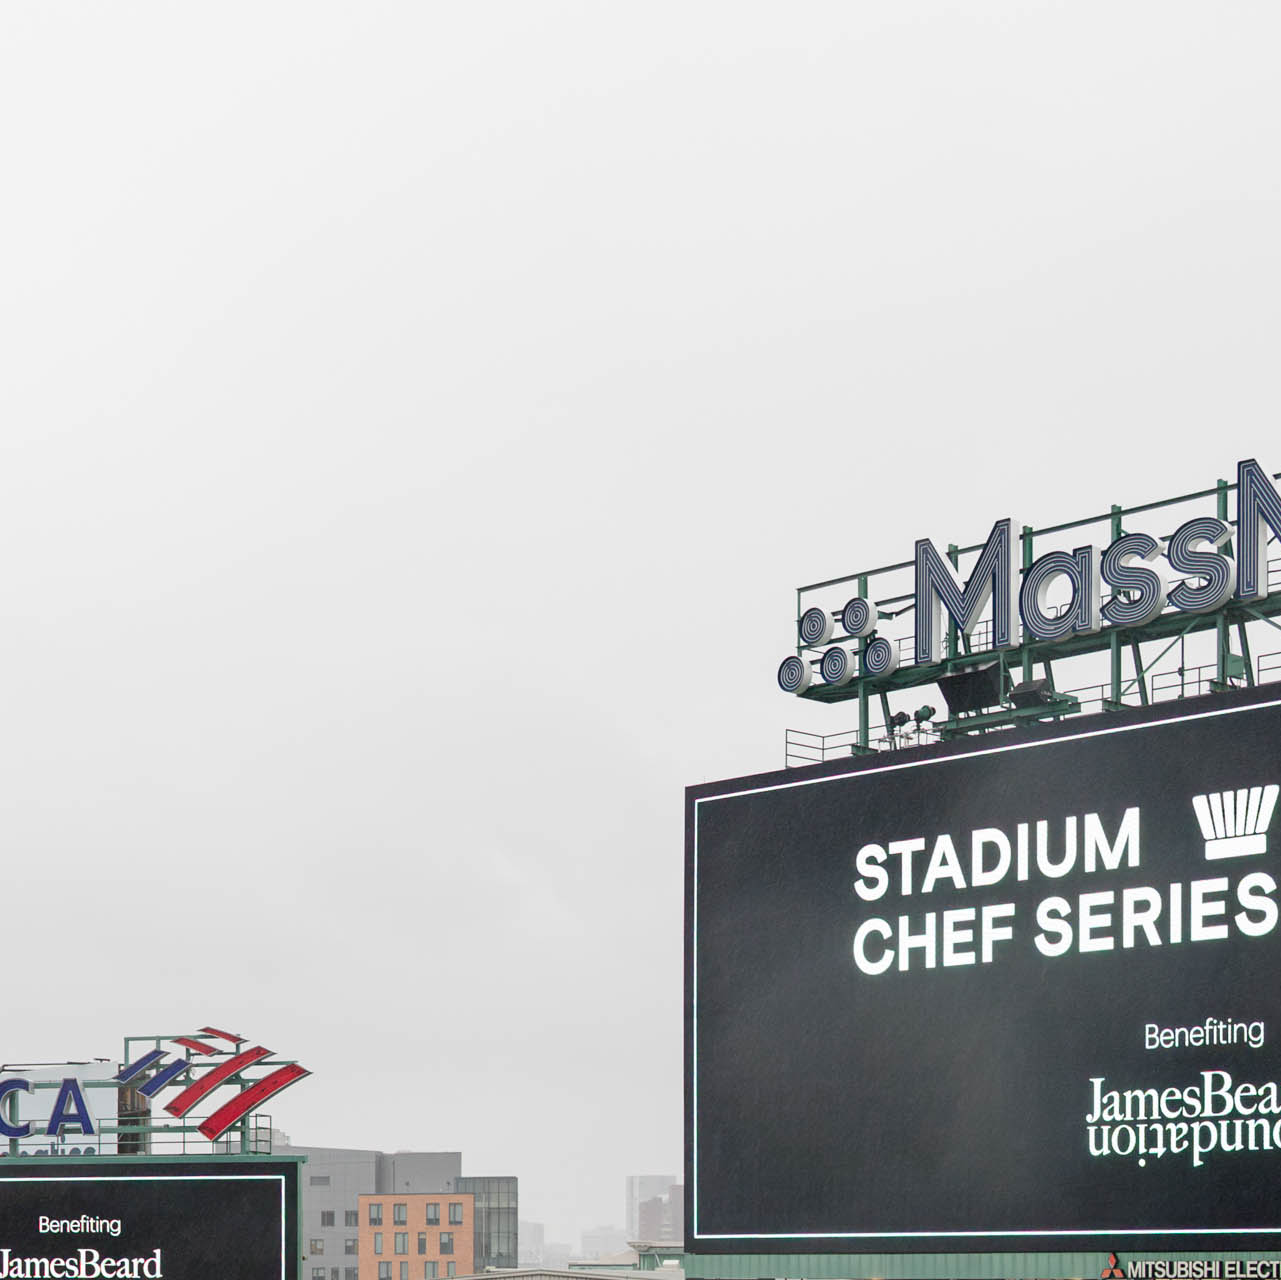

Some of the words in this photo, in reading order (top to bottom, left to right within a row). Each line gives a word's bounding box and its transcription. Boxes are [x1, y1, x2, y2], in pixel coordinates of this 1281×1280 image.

[853, 806, 1140, 901] STADIUM
[853, 902, 1016, 976] CHEF
[1034, 871, 1280, 957] SERIES
[1145, 1017, 1265, 1050] Benefiting
[38, 1214, 122, 1237] Benefiting
[1127, 1260, 1220, 1279] MITSUBISHI
